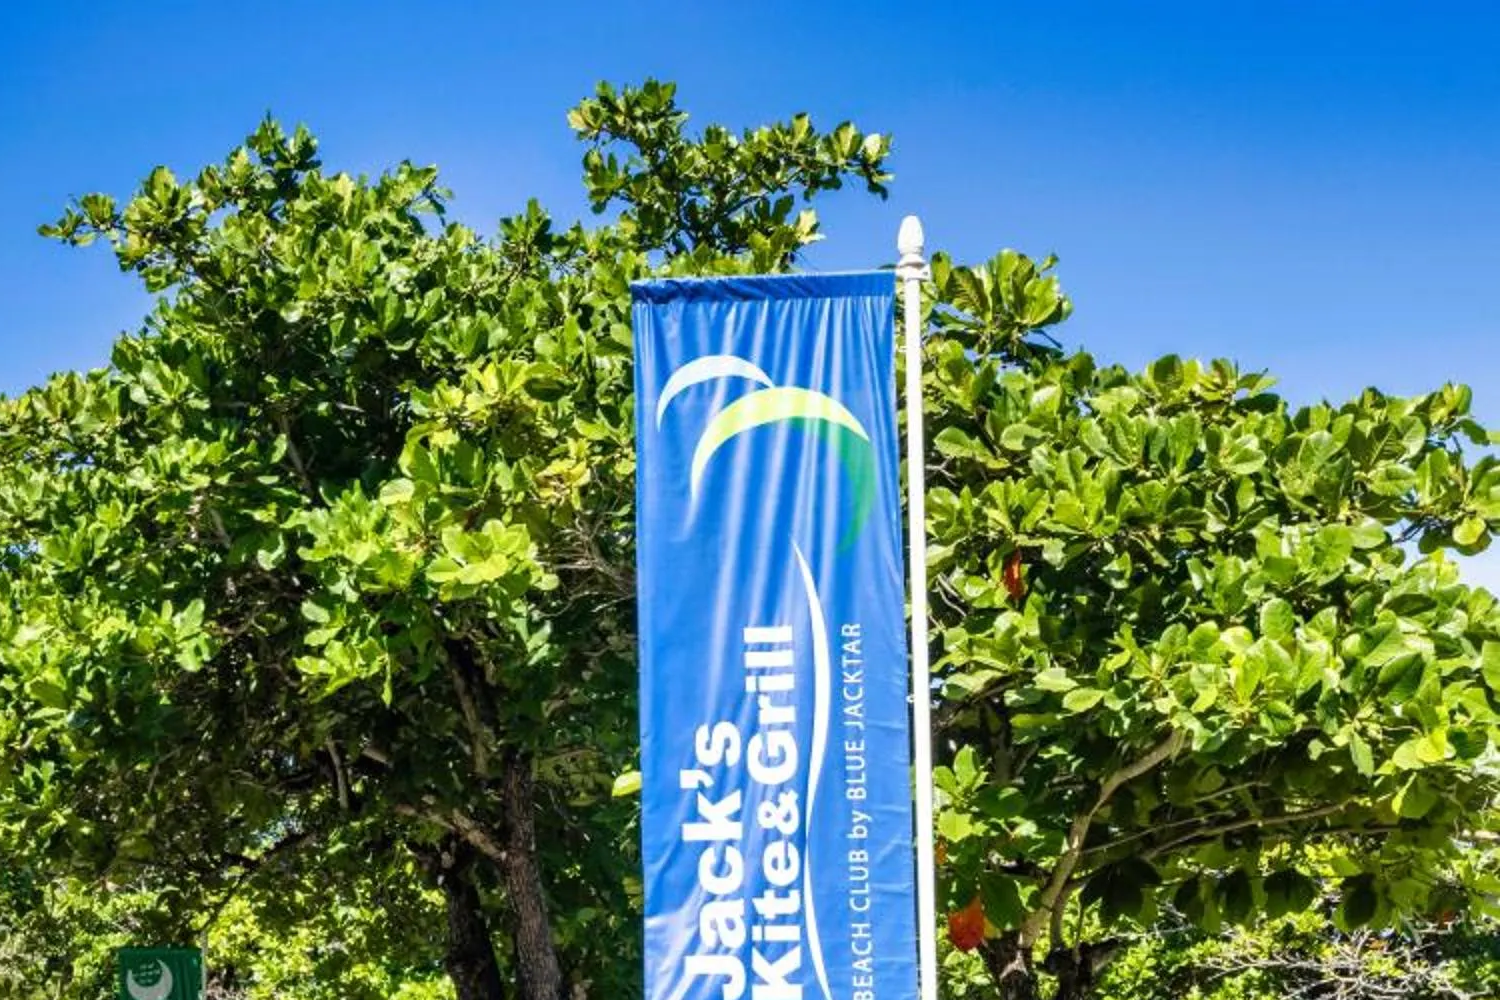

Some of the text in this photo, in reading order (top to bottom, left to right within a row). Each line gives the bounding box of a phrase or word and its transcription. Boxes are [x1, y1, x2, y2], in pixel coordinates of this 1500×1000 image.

[840, 621, 864, 731] JACKTAR
[845, 734, 867, 801] BLUE
[847, 811, 874, 840] by
[850, 849, 870, 913] CLUB
